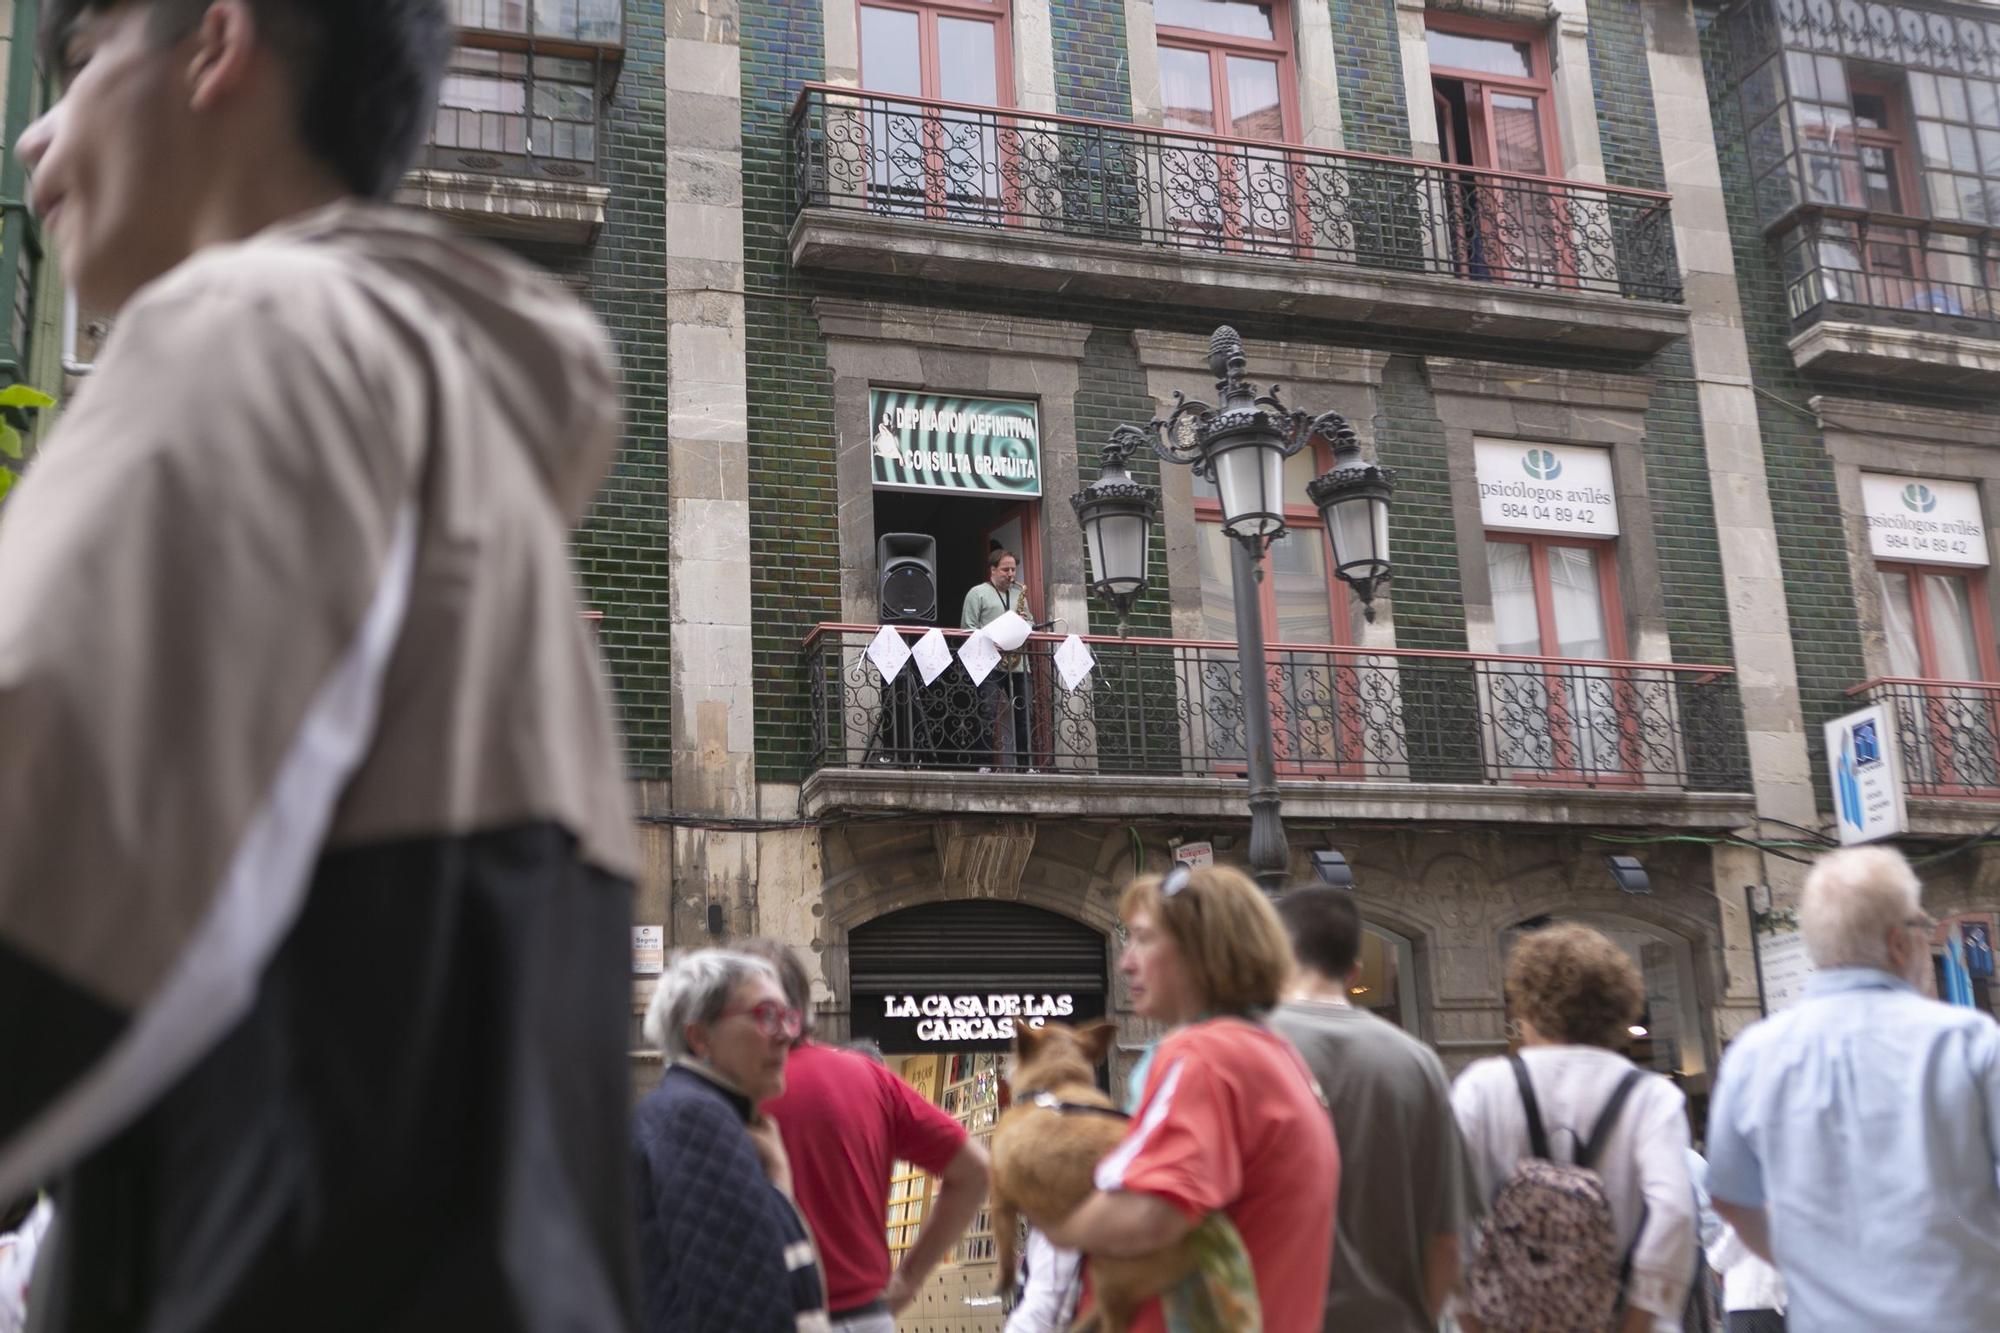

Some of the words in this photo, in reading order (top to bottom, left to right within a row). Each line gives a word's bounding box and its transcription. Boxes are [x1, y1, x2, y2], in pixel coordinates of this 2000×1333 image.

[896, 408, 967, 434] DEPILACION
[970, 414, 1035, 439] DEFINITIVA
[904, 450, 972, 474] CONSULTA
[974, 455, 1036, 479] GRATUITA
[1480, 481, 1563, 503] psicólogos
[1567, 487, 1611, 505] avilés
[1501, 503, 1528, 518] 984
[1533, 505, 1550, 520] 04
[1555, 507, 1573, 522] 89
[1577, 509, 1595, 524] 42
[884, 995, 920, 1017] LA
[921, 994, 986, 1017] CASA
[987, 994, 1021, 1017] DE
[1023, 994, 1074, 1016] LAS
[916, 1017, 1045, 1041] CARCASS
